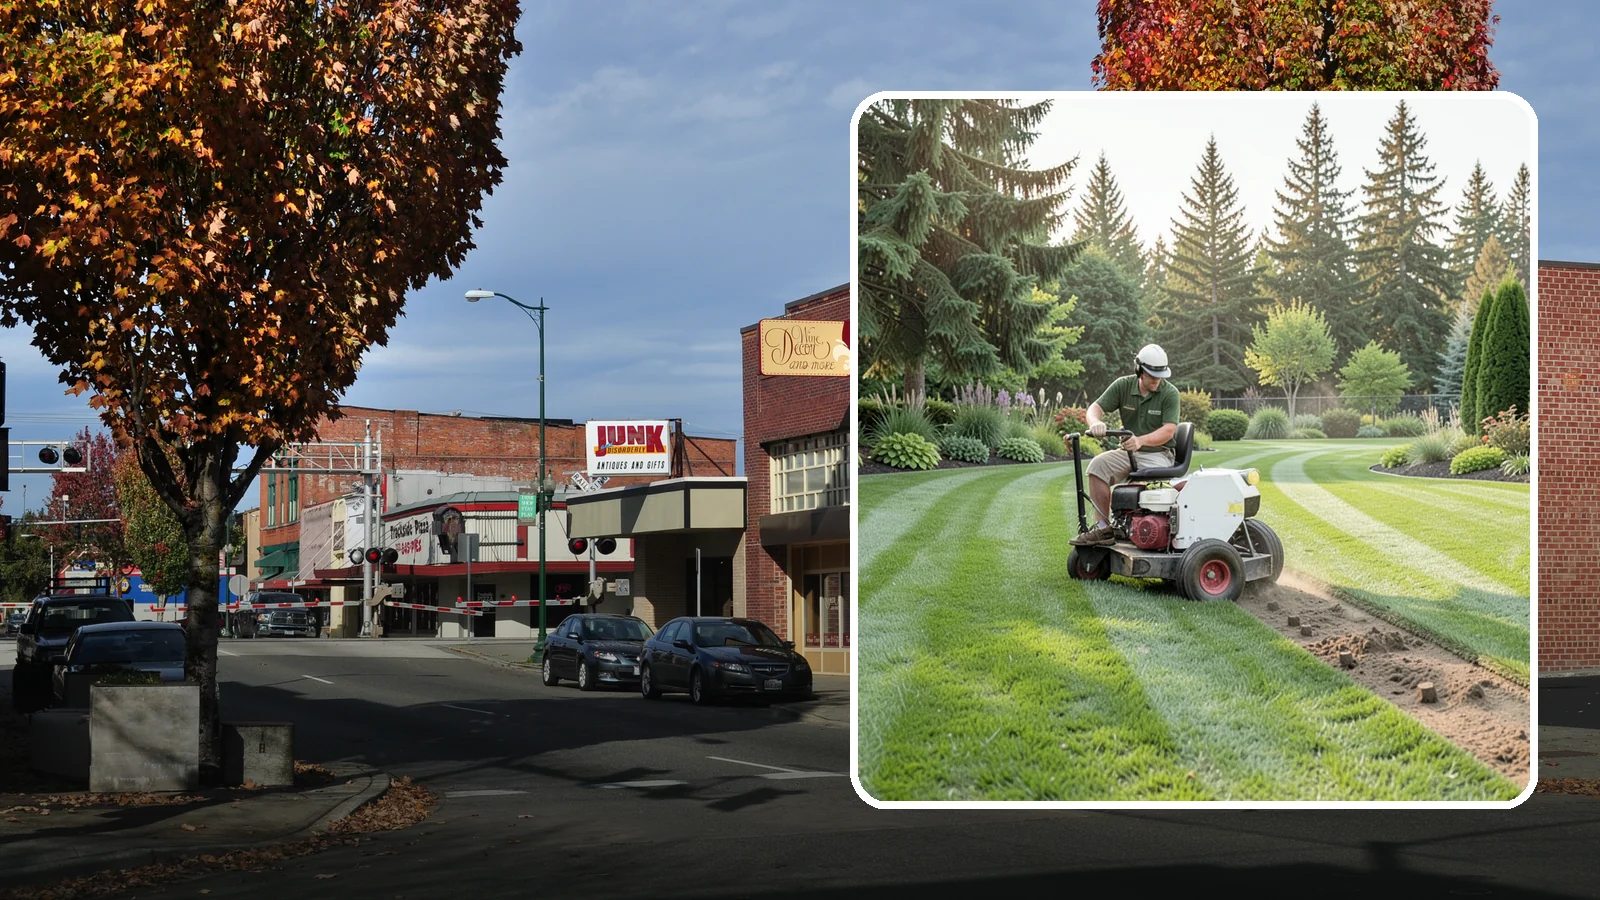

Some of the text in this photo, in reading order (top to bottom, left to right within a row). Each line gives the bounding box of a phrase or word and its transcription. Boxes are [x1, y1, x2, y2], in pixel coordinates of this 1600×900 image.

[596, 425, 665, 457] JUNK
[597, 460, 665, 470] ANTIQUES AND GIFTS
[415, 519, 429, 534] Pizza
